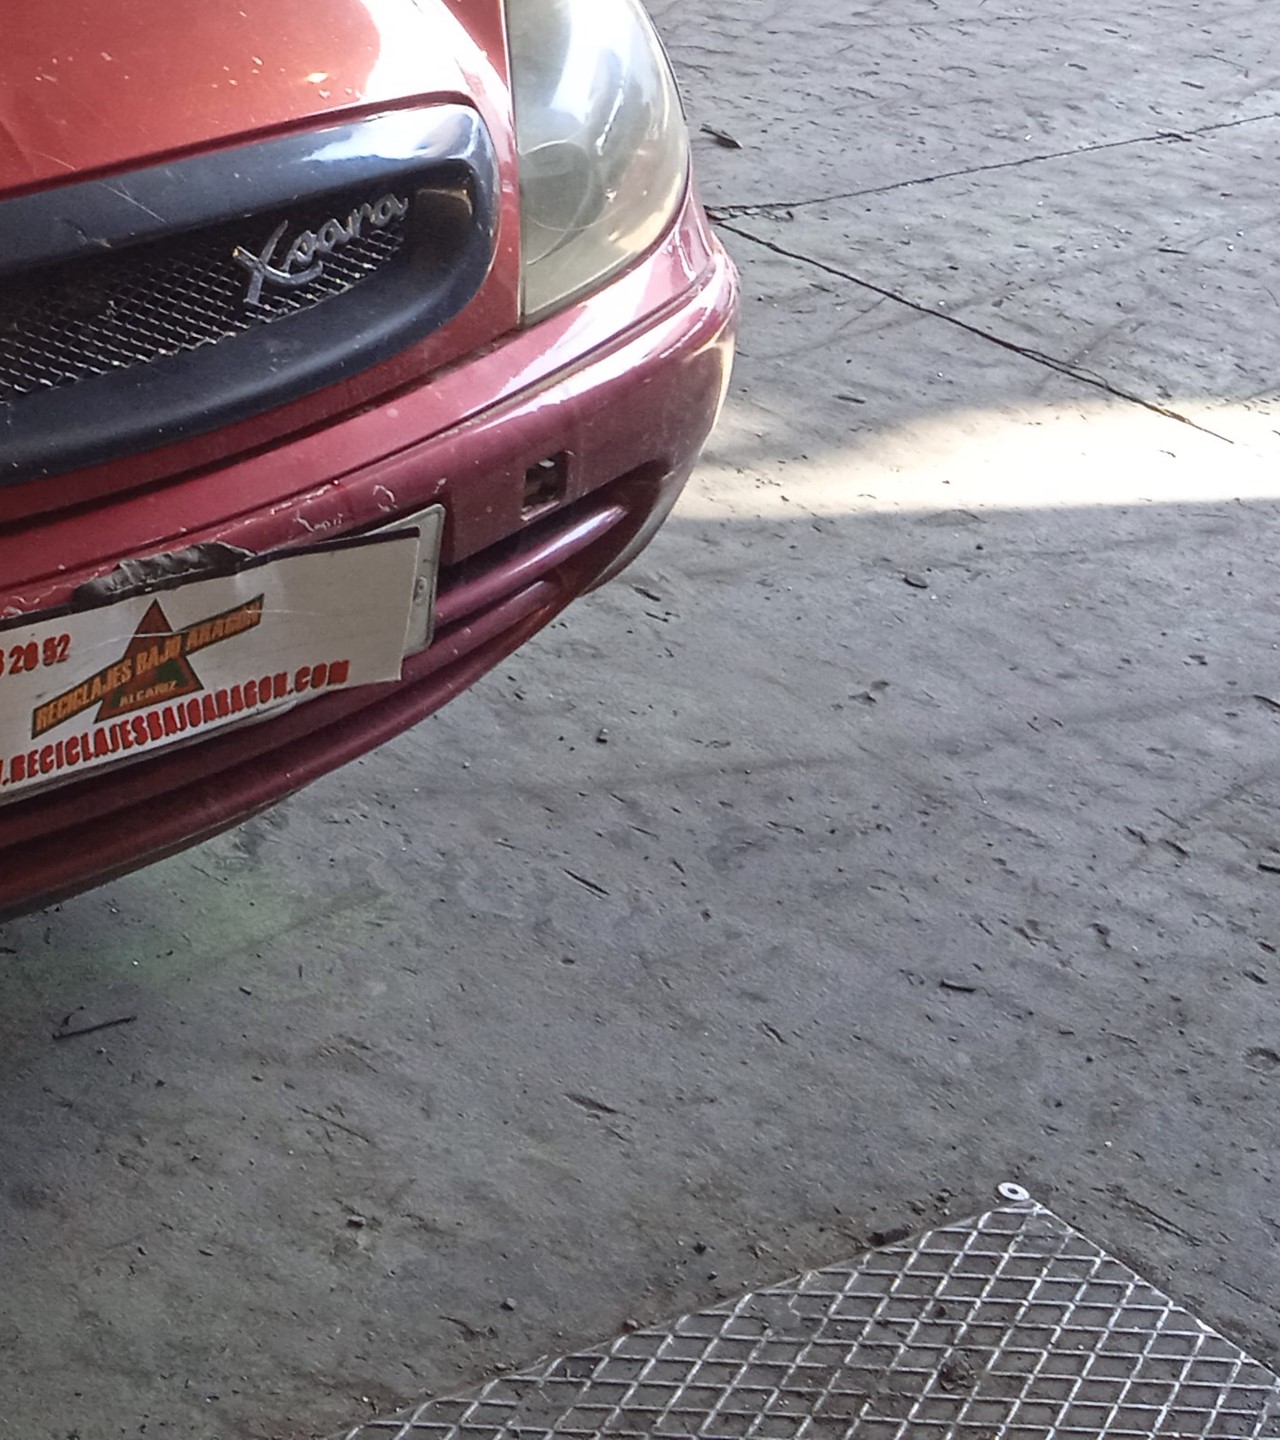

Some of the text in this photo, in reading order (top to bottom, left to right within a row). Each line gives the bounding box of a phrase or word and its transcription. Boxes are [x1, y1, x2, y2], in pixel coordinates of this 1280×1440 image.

[232, 193, 409, 305] Xsara
[35, 659, 133, 731] RECICLAJES
[135, 636, 182, 679] BAJO
[42, 633, 71, 667] 52
